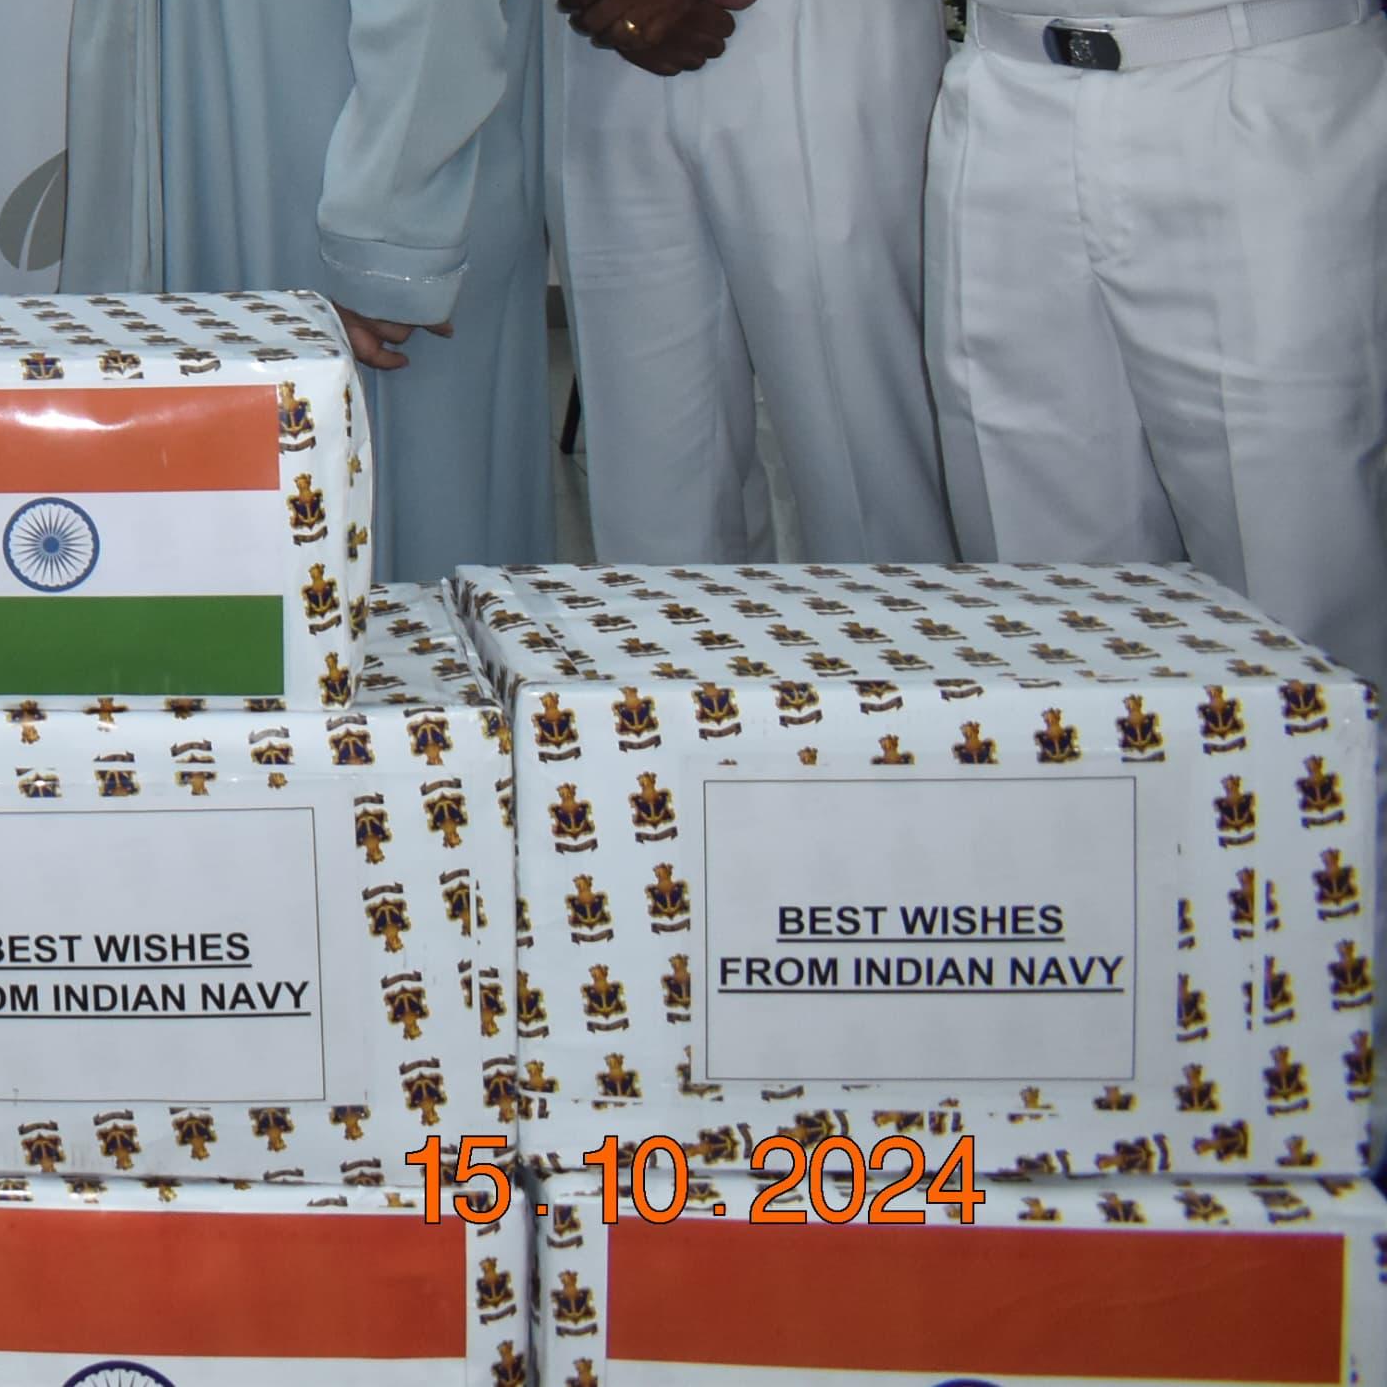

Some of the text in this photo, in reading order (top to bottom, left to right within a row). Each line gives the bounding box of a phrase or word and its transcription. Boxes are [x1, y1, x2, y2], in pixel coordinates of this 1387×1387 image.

[778, 904, 1064, 935] BEST WISHES
[94, 932, 251, 962] WISHES
[719, 956, 1124, 986] FROM INDIAN NAVY
[53, 982, 186, 1012] INDIAN
[200, 980, 309, 1011] NAVY
